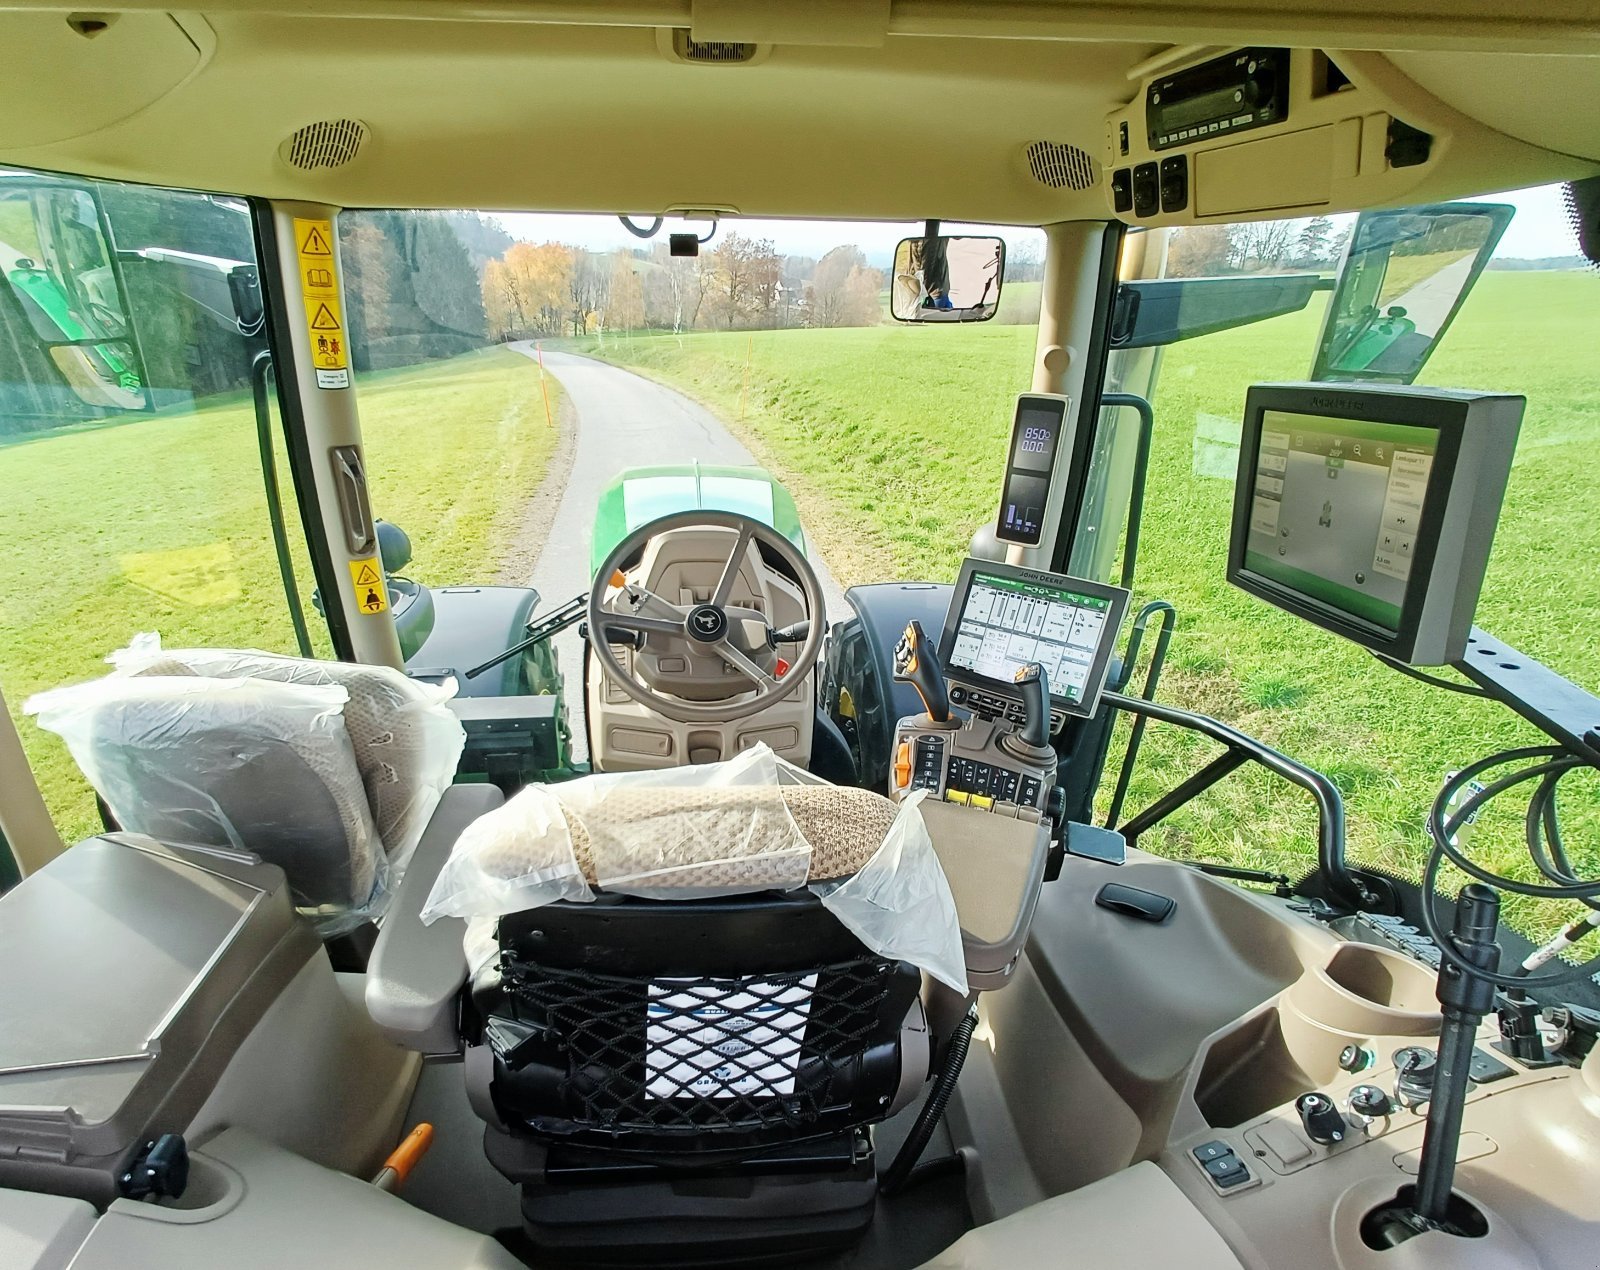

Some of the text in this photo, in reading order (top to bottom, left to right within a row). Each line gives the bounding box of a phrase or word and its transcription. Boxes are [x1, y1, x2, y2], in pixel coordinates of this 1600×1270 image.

[1025, 427, 1046, 440] 850
[1019, 571, 1064, 585] JOHN DEERE
